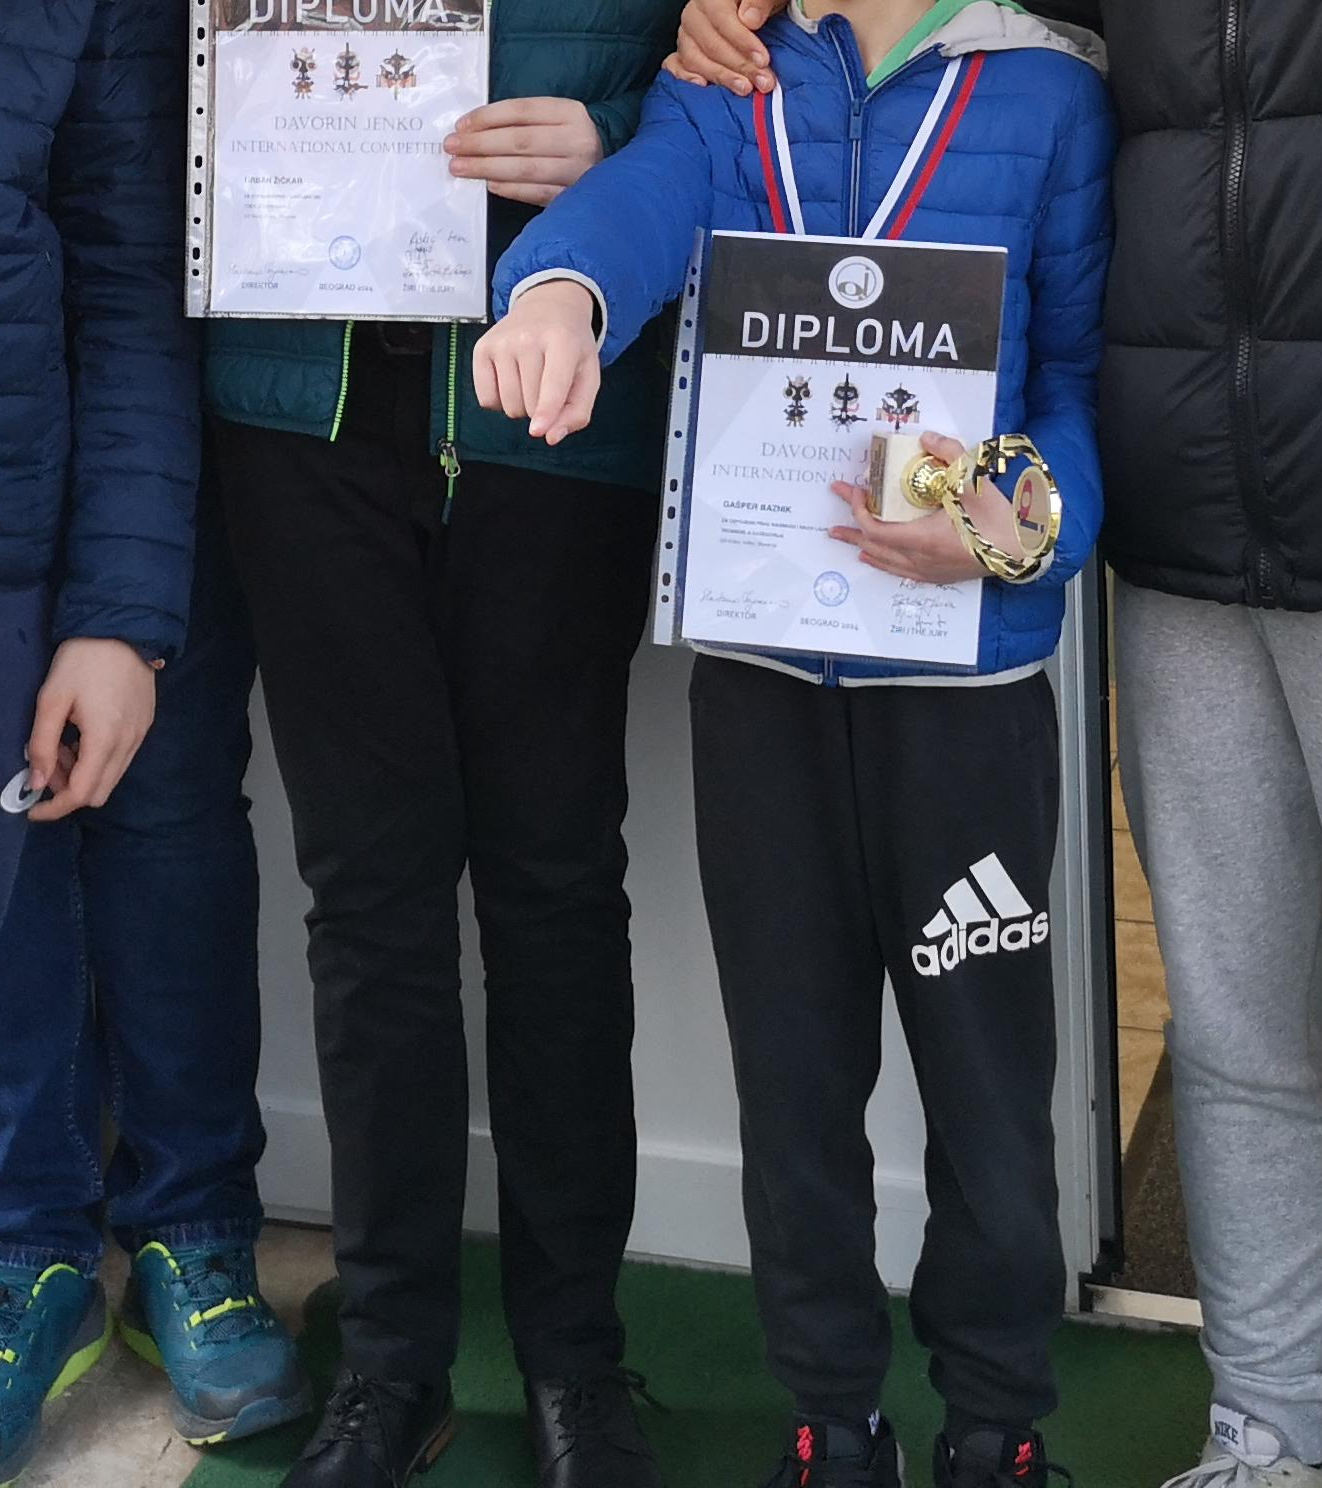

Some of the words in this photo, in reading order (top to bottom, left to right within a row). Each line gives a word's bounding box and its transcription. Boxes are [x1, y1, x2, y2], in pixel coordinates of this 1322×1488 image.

[275, 116, 357, 131] DAVORIN
[363, 116, 423, 131] JENKO
[231, 140, 354, 153] INTERNATIONAL
[360, 141, 443, 154] COMPETITI
[741, 311, 961, 362] DIPLOMA
[762, 442, 852, 463] DAVORIN
[712, 464, 845, 483] INTERNATIONAL
[911, 911, 1049, 976] adidas
[1214, 1420, 1239, 1445] NIKE
